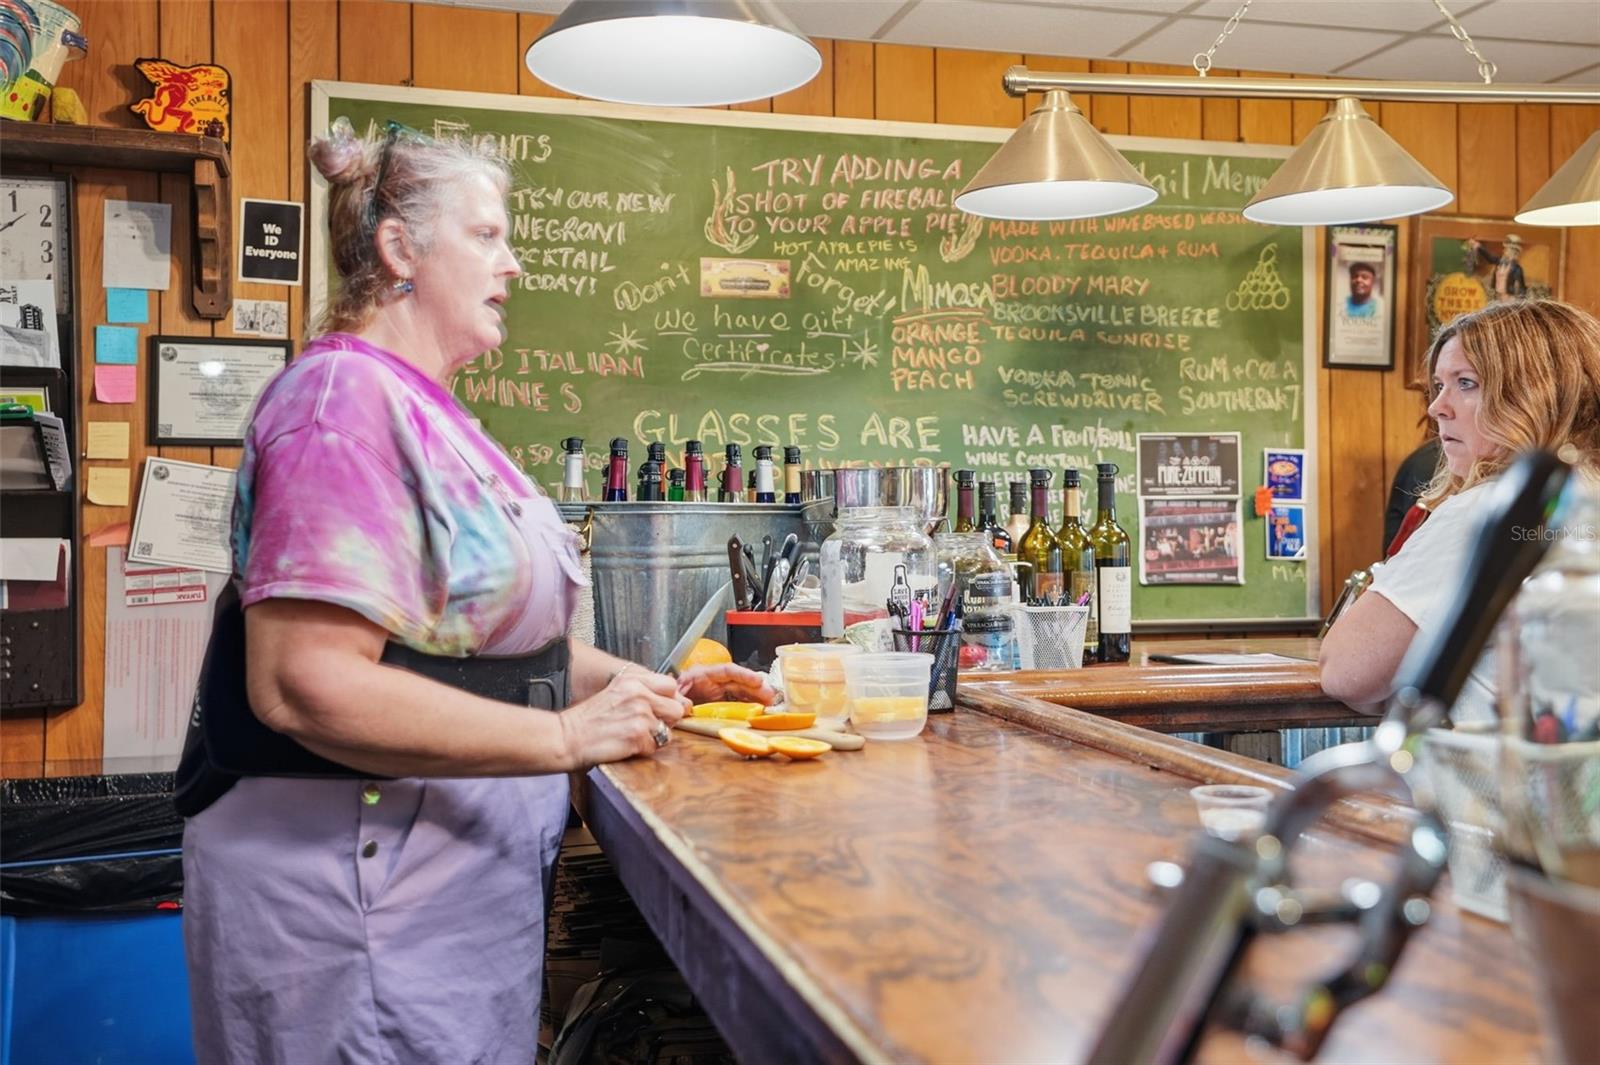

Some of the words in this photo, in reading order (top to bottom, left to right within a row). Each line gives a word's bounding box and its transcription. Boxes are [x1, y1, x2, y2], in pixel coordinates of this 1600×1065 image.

[189, 95, 228, 107] FIREBALL
[752, 154, 825, 187] TRY
[830, 154, 940, 188] ADDING
[942, 158, 962, 180] A
[8, 190, 17, 212] 1
[511, 187, 564, 210] TRY
[567, 190, 611, 209] OUR
[616, 191, 676, 213] NEW
[736, 190, 808, 214] SHOT
[822, 192, 850, 210] OF
[39, 204, 52, 228] 2
[726, 215, 756, 235] TO
[765, 215, 832, 235] YOUR
[840, 214, 912, 238] APPLE
[263, 223, 282, 235] We
[264, 235, 279, 246] ID
[513, 213, 627, 246] NEGRONI
[989, 221, 1040, 240] MADE
[1050, 217, 1099, 236] WITH
[40, 240, 53, 264] 3
[245, 246, 297, 260] Everyone
[512, 246, 616, 273] OCKTAIL
[774, 240, 812, 256] HOT
[817, 240, 866, 255] APPLE
[868, 240, 893, 252] PIE
[1065, 243, 1153, 261] TEQUILA
[1176, 241, 1219, 258] RUM
[991, 273, 1082, 298] BLOODY
[1087, 274, 1151, 297] MARY
[714, 304, 790, 331] have
[993, 300, 1135, 326] BROOKSVILLE
[1140, 304, 1220, 328] BREEZE
[891, 322, 986, 346] ORANGE
[991, 325, 1088, 342] TEQUILA
[1097, 331, 1192, 351] SUNRISE
[516, 348, 645, 378] ITALIAN
[892, 346, 981, 371] MANGO
[1179, 355, 1230, 384] RUM
[890, 368, 975, 392] PEACH
[998, 366, 1076, 389] VODKA
[1080, 372, 1156, 392] TONIC
[1003, 389, 1167, 416] SCREWDRIVER
[633, 409, 840, 451] GLASSES
[861, 412, 941, 452] ARE
[962, 424, 1021, 448] HAVE
[1026, 424, 1045, 447] A
[965, 451, 1011, 467] WINE
